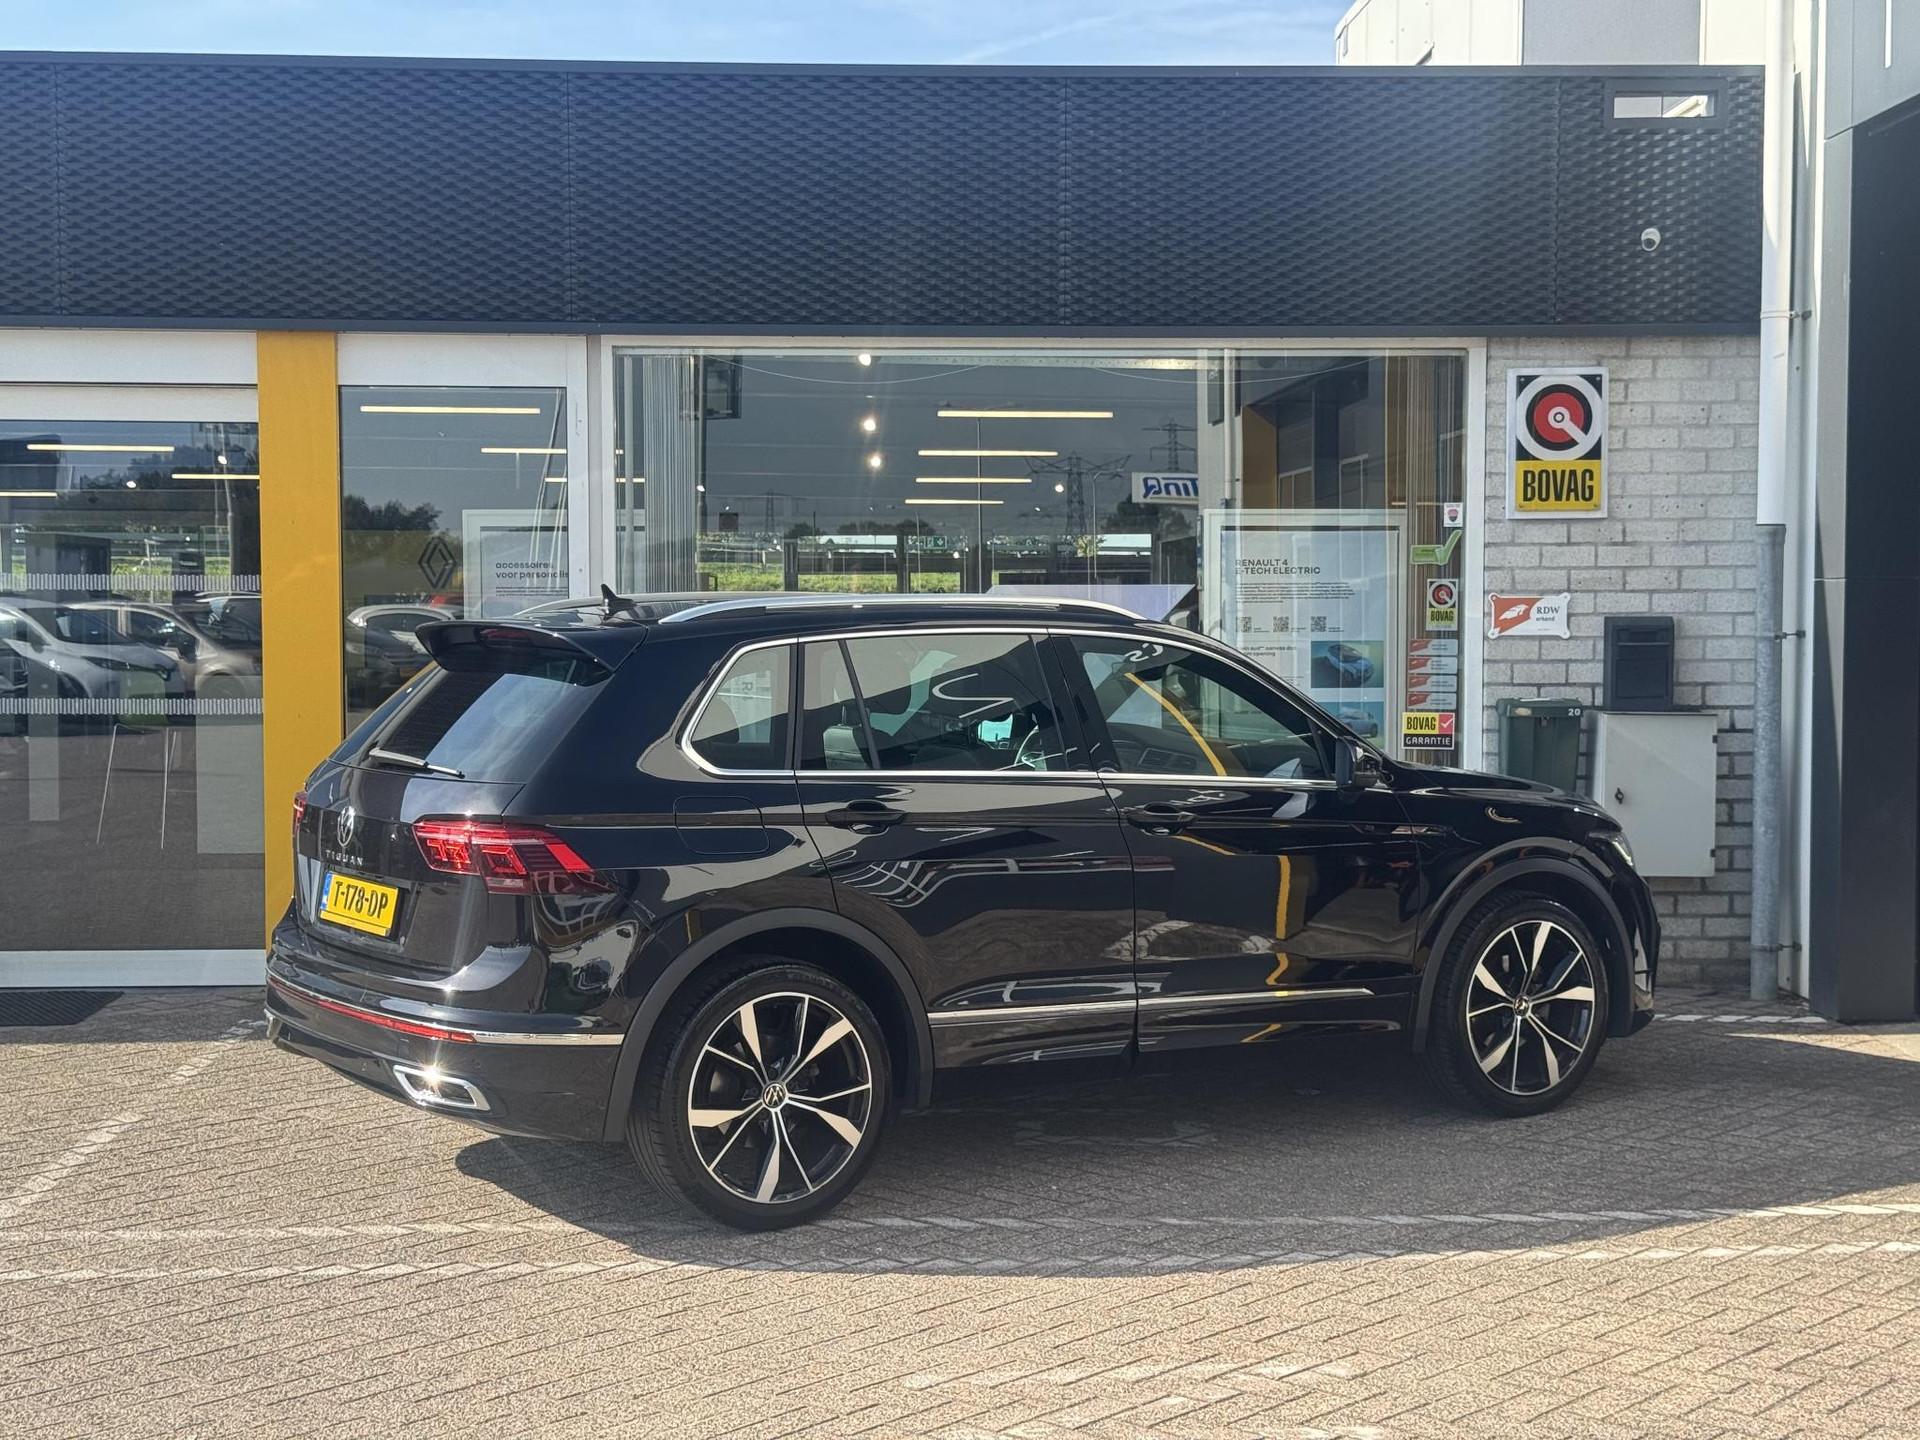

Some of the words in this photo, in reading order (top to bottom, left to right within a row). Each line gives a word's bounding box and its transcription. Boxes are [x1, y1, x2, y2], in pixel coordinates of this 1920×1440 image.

[1522, 468, 1595, 503] BOVAG
[1235, 559, 1281, 567] RENAULT
[1282, 559, 1289, 567] 4
[495, 571, 518, 579] voor
[1235, 566, 1271, 574] E-TECH
[1273, 566, 1321, 574] ELECTRIC
[1536, 606, 1560, 615] RDW
[1430, 610, 1454, 622] BOVAG
[1567, 708, 1581, 716] 20
[1406, 716, 1437, 731] BOVAG
[1405, 736, 1451, 746] GARANTIE
[325, 849, 364, 866] TIGUAN
[333, 881, 389, 918] T-178-DP
